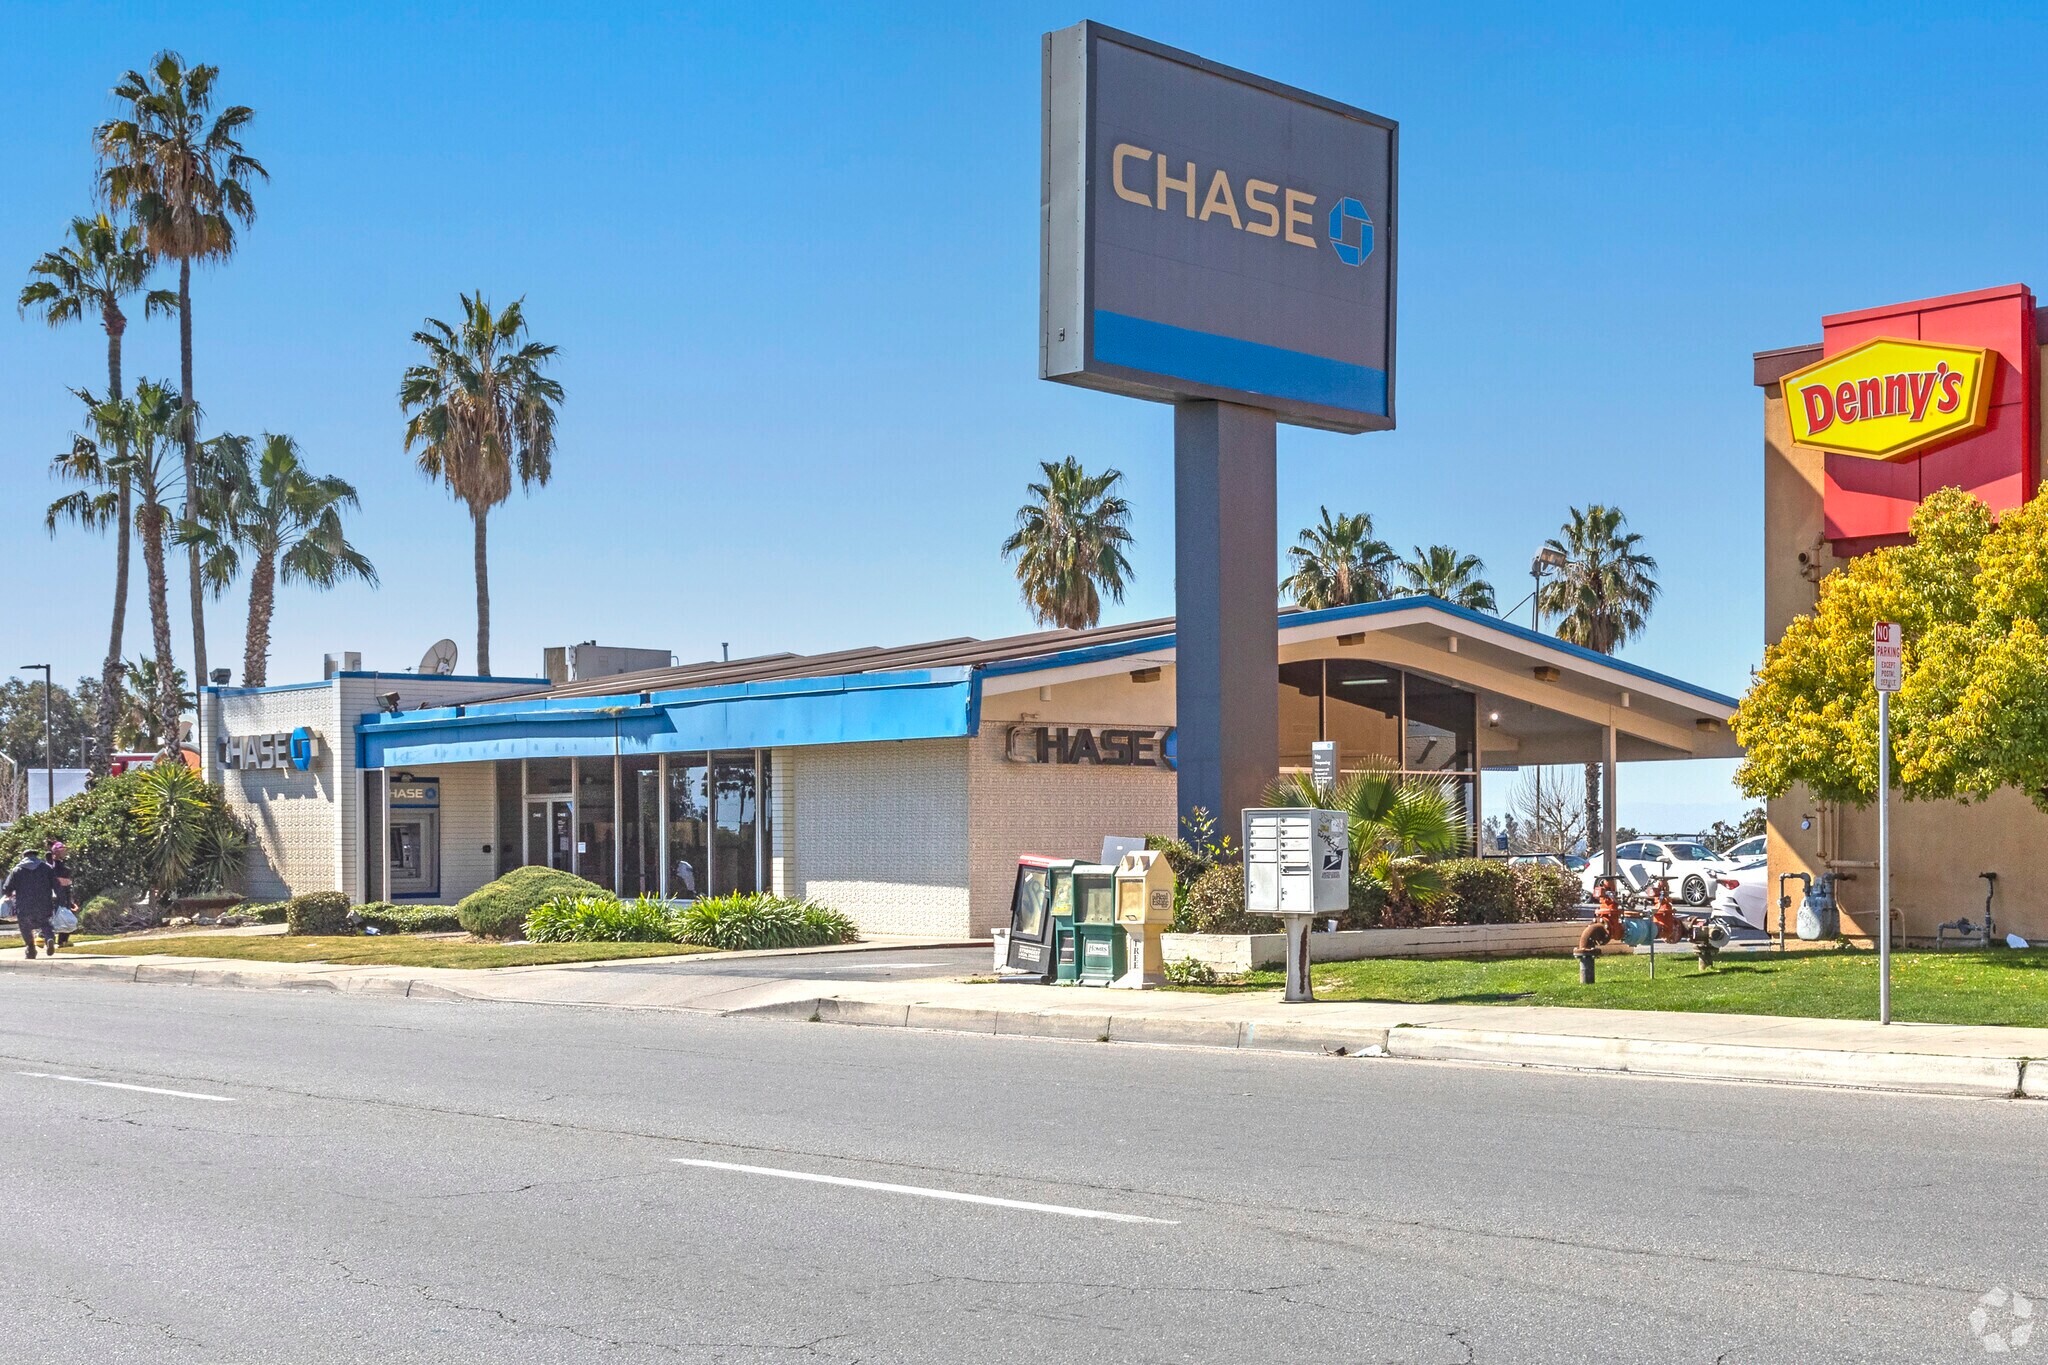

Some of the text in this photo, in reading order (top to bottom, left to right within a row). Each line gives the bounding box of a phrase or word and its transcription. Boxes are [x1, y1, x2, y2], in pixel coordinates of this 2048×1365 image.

[1112, 143, 1318, 249] CHASE
[1799, 361, 1964, 436] Denny's
[1877, 625, 1889, 641] NO
[1877, 646, 1900, 657] PARKING
[215, 732, 290, 770] CHASE
[1006, 725, 1158, 766] CHASE
[389, 788, 424, 798] HASE
